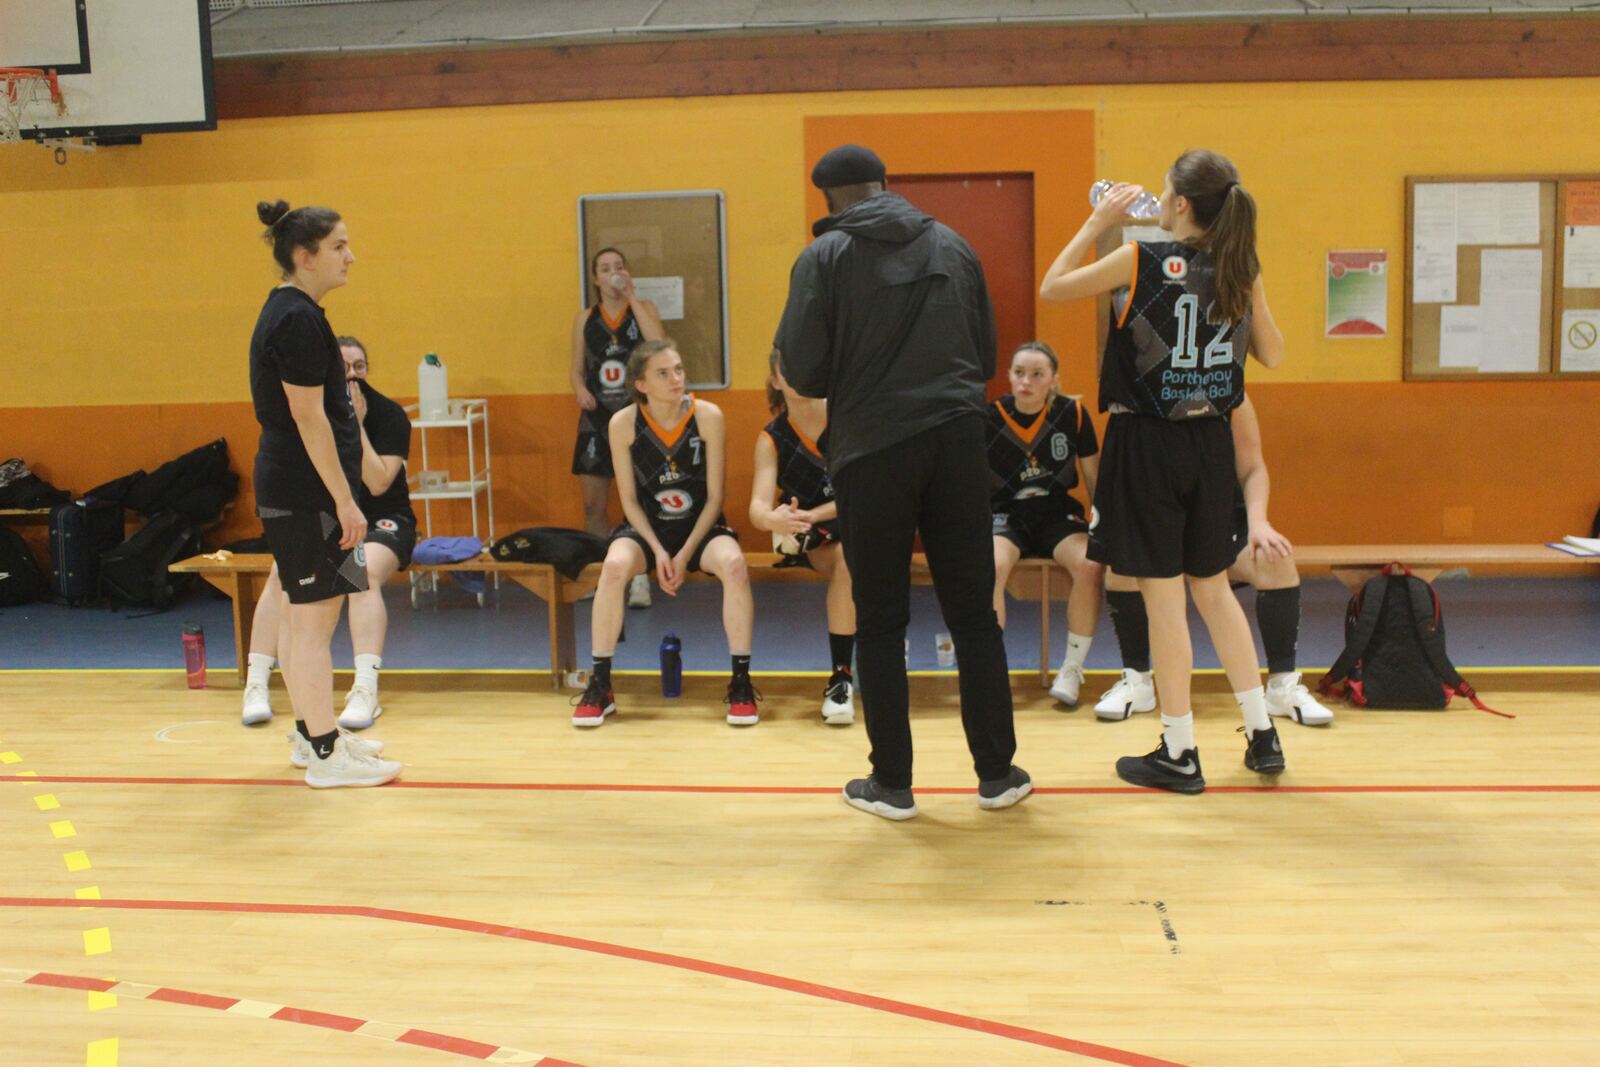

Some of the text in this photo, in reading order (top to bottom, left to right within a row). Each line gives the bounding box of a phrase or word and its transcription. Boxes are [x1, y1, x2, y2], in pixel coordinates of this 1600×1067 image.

[1171, 294, 1233, 368] 12
[689, 436, 701, 466] 7
[1050, 432, 1069, 461] 6
